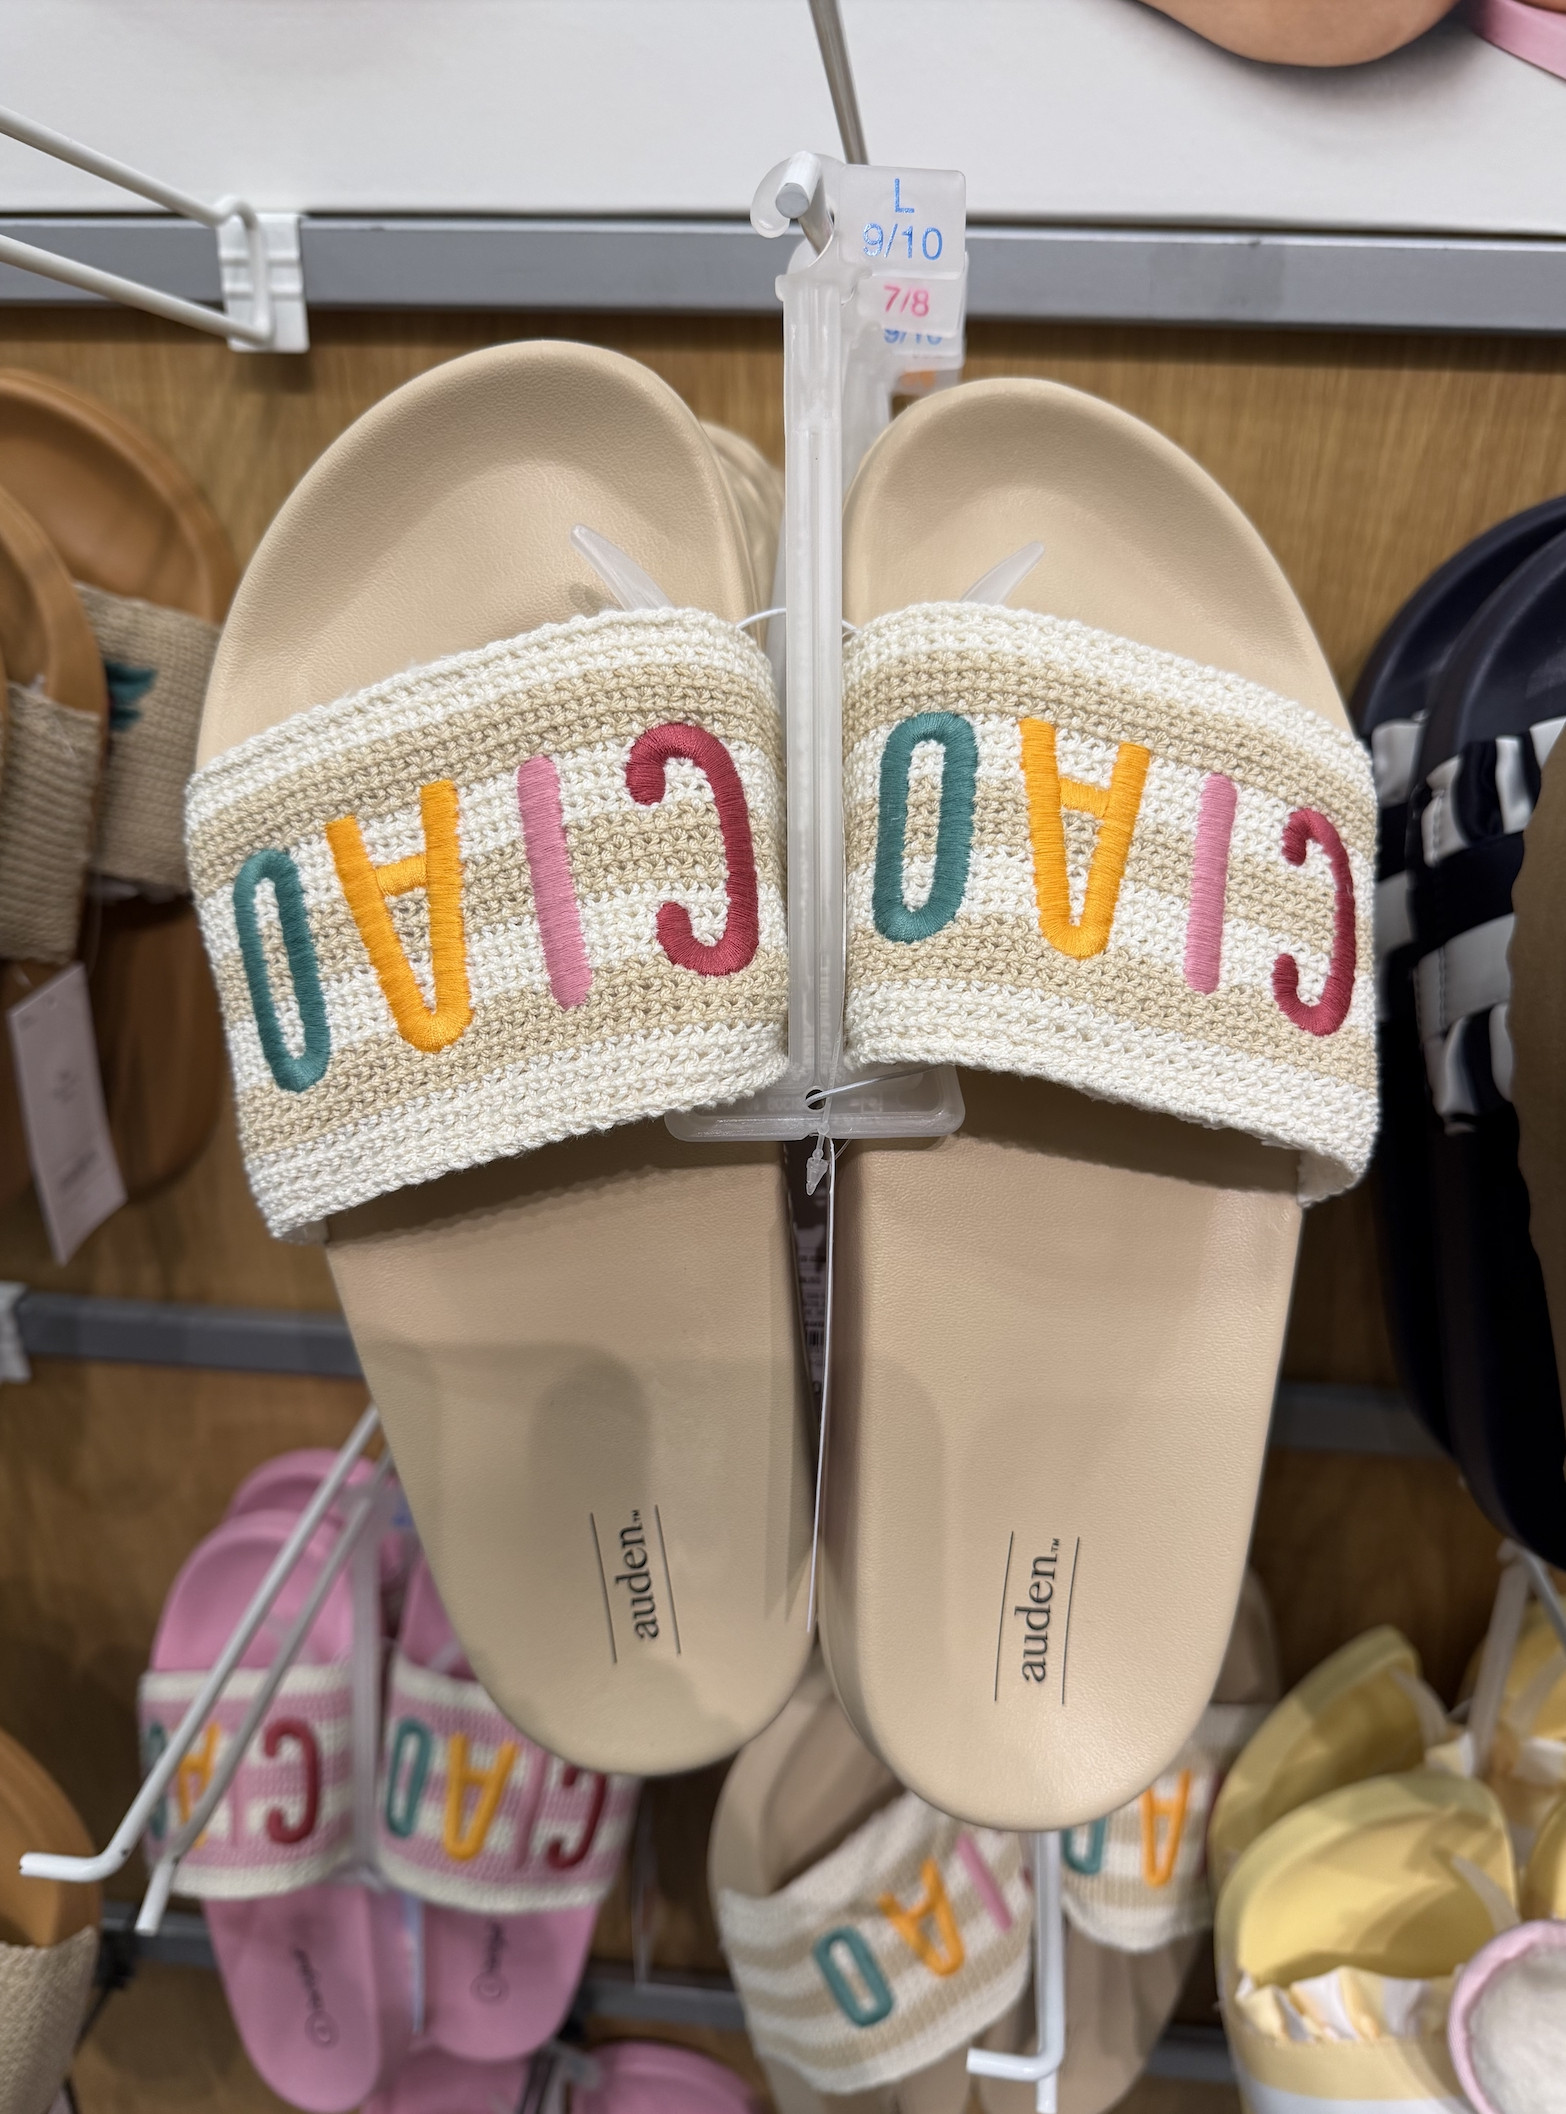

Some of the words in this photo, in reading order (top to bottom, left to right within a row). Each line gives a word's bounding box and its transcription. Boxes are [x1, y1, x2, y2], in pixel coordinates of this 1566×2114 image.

[863, 223, 943, 261] 9/10
[894, 178, 915, 213] L
[883, 285, 930, 318] 7/8
[232, 721, 759, 1093] CIAO
[871, 711, 1356, 1037] CIAO
[814, 1828, 1033, 2028] IAO
